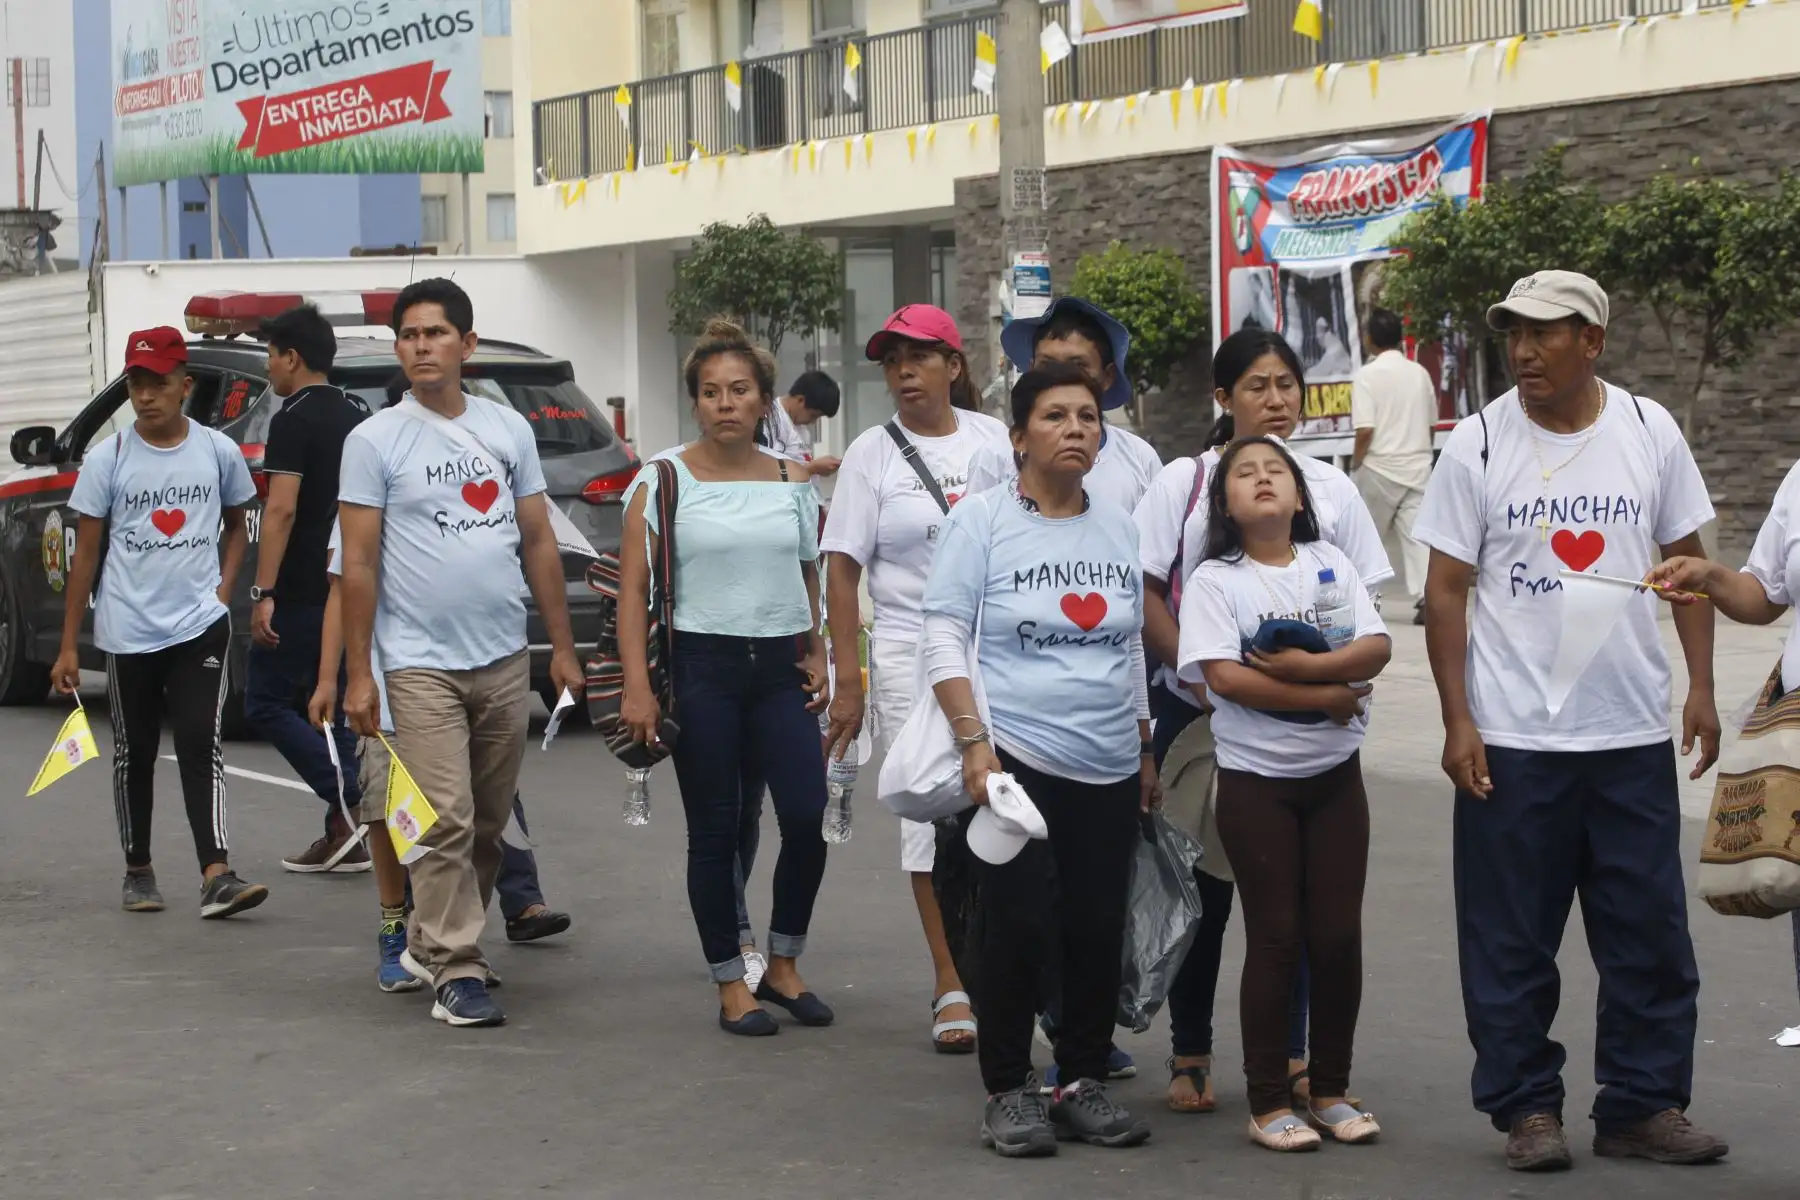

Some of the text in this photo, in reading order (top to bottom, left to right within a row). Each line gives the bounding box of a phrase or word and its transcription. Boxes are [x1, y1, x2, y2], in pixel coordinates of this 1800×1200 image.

[233, 0, 373, 53] Últimos
[211, 10, 475, 93] Departamentos
[170, 71, 199, 105] PILOTO
[267, 84, 373, 126] ENTREGA
[299, 96, 421, 143] INMEDIATA
[1288, 147, 1442, 220] FRANCISCO
[125, 484, 212, 510] MANCHAY
[1507, 495, 1641, 530] MANCHAY
[1014, 560, 1130, 592] MANCHAY
